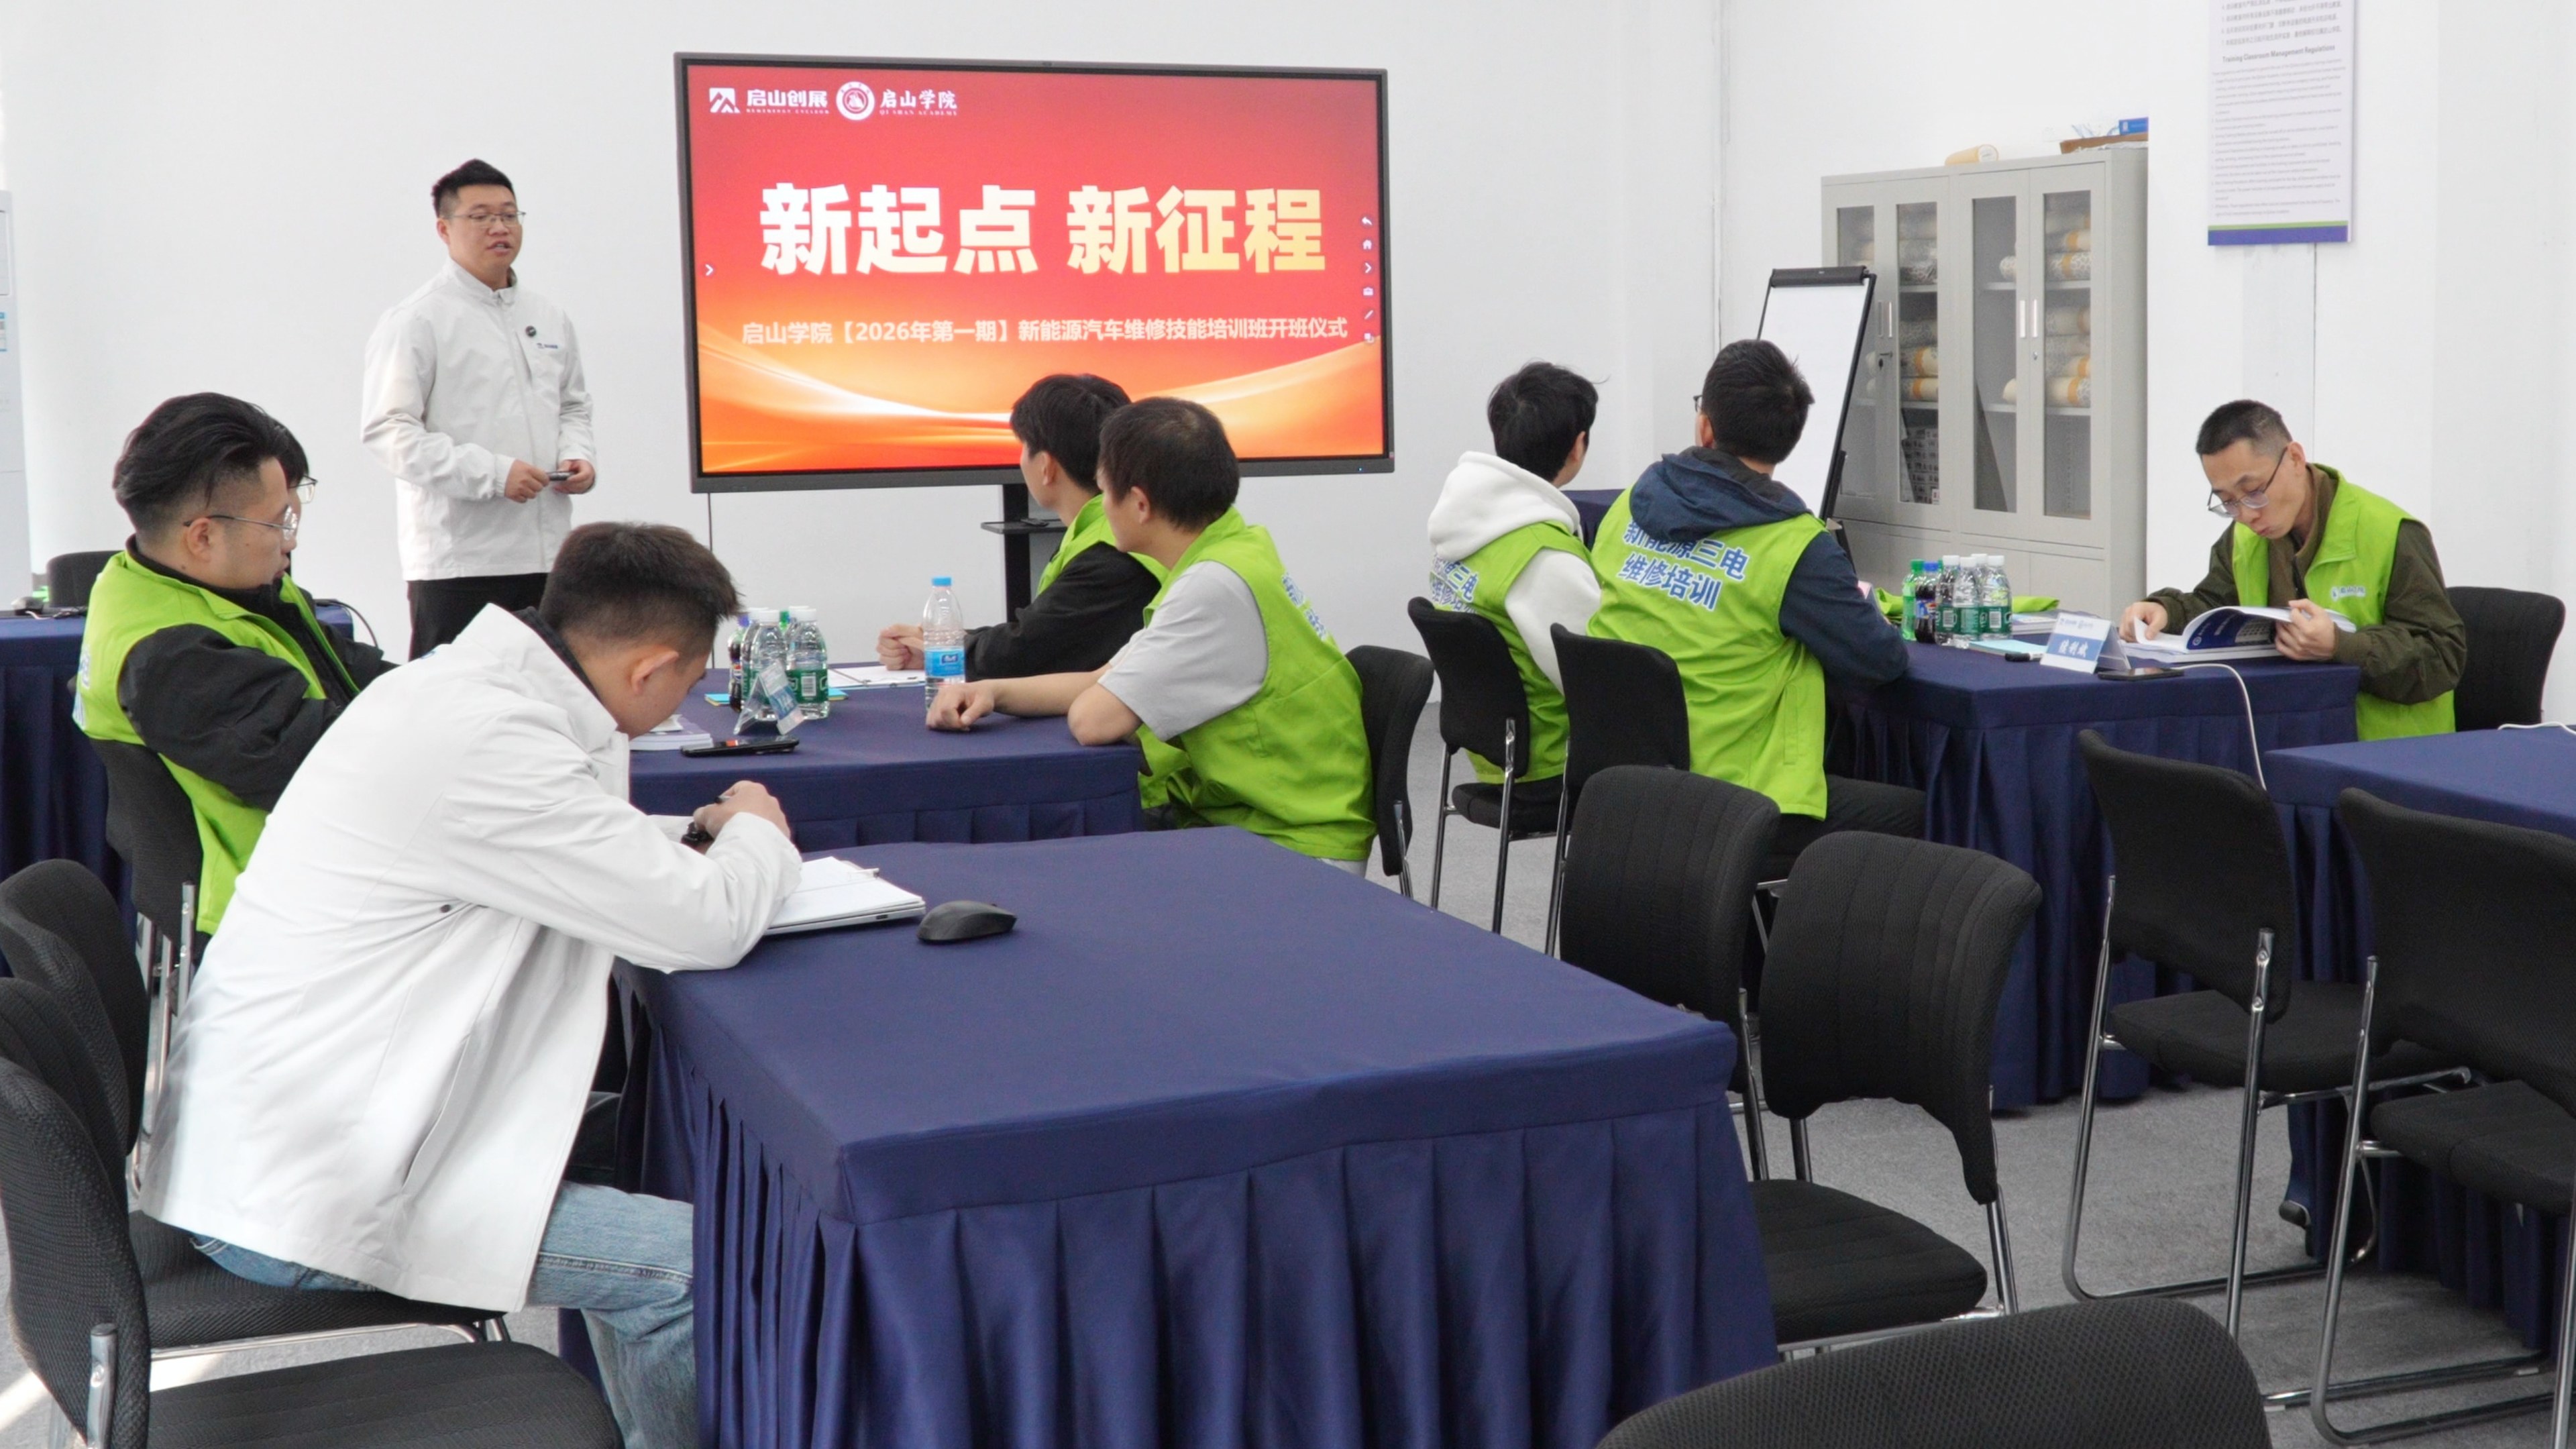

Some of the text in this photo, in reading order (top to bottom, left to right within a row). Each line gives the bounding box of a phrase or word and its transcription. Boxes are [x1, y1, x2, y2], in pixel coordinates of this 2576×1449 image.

[2271, 48, 2304, 57] Management
[2304, 45, 2335, 54] Regulations
[747, 89, 828, 107] 启山创展
[880, 89, 957, 109] 启山学院
[759, 182, 1326, 276] 新起点 新征程
[1617, 553, 1722, 610] 维修培训
